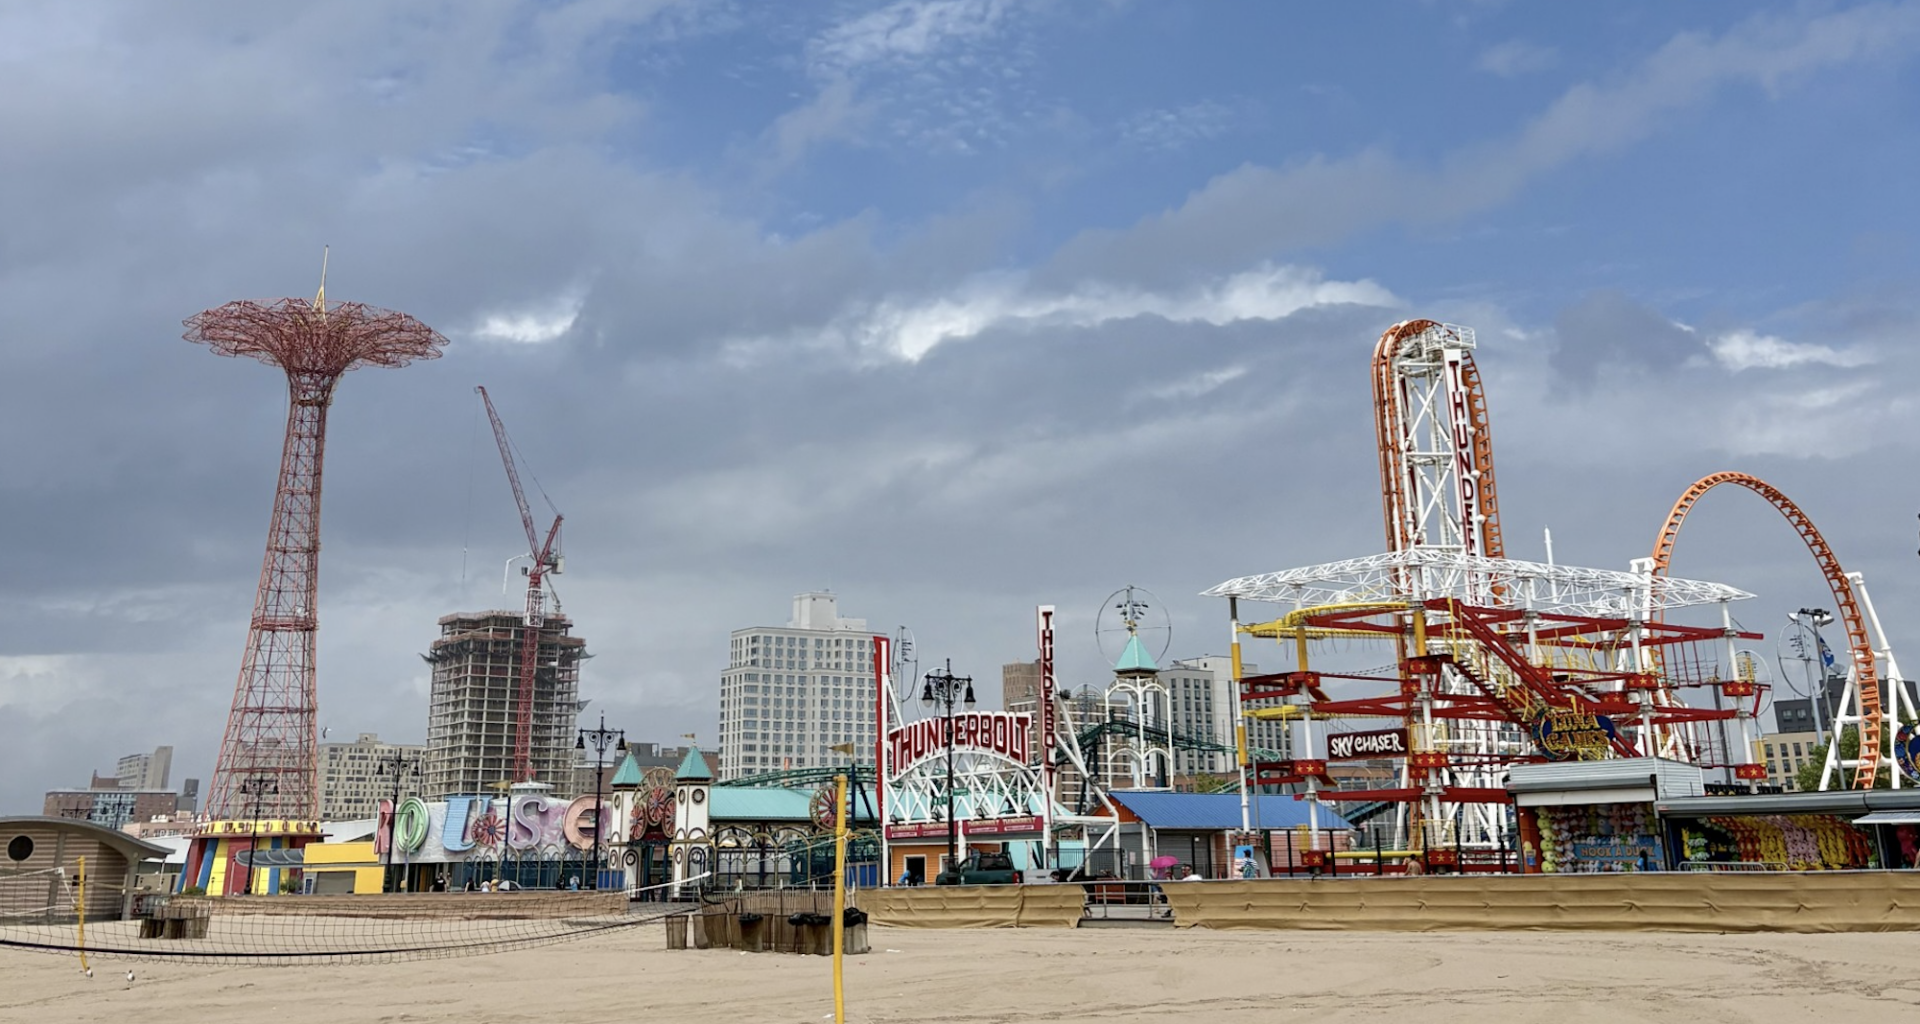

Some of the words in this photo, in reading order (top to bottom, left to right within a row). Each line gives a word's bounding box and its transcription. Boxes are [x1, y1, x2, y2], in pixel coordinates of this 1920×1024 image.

[1449, 361, 1477, 566] THUNDER
[1042, 611, 1055, 787] THUNDERBOLT
[1550, 713, 1600, 732] LUNA
[889, 713, 1030, 778] THUNDERBOLT
[1331, 734, 1353, 757] SKY
[1354, 732, 1405, 753] CHASER
[1546, 730, 1610, 751] GAMES
[1581, 847, 1611, 857] HOOK
[1615, 847, 1622, 857] A
